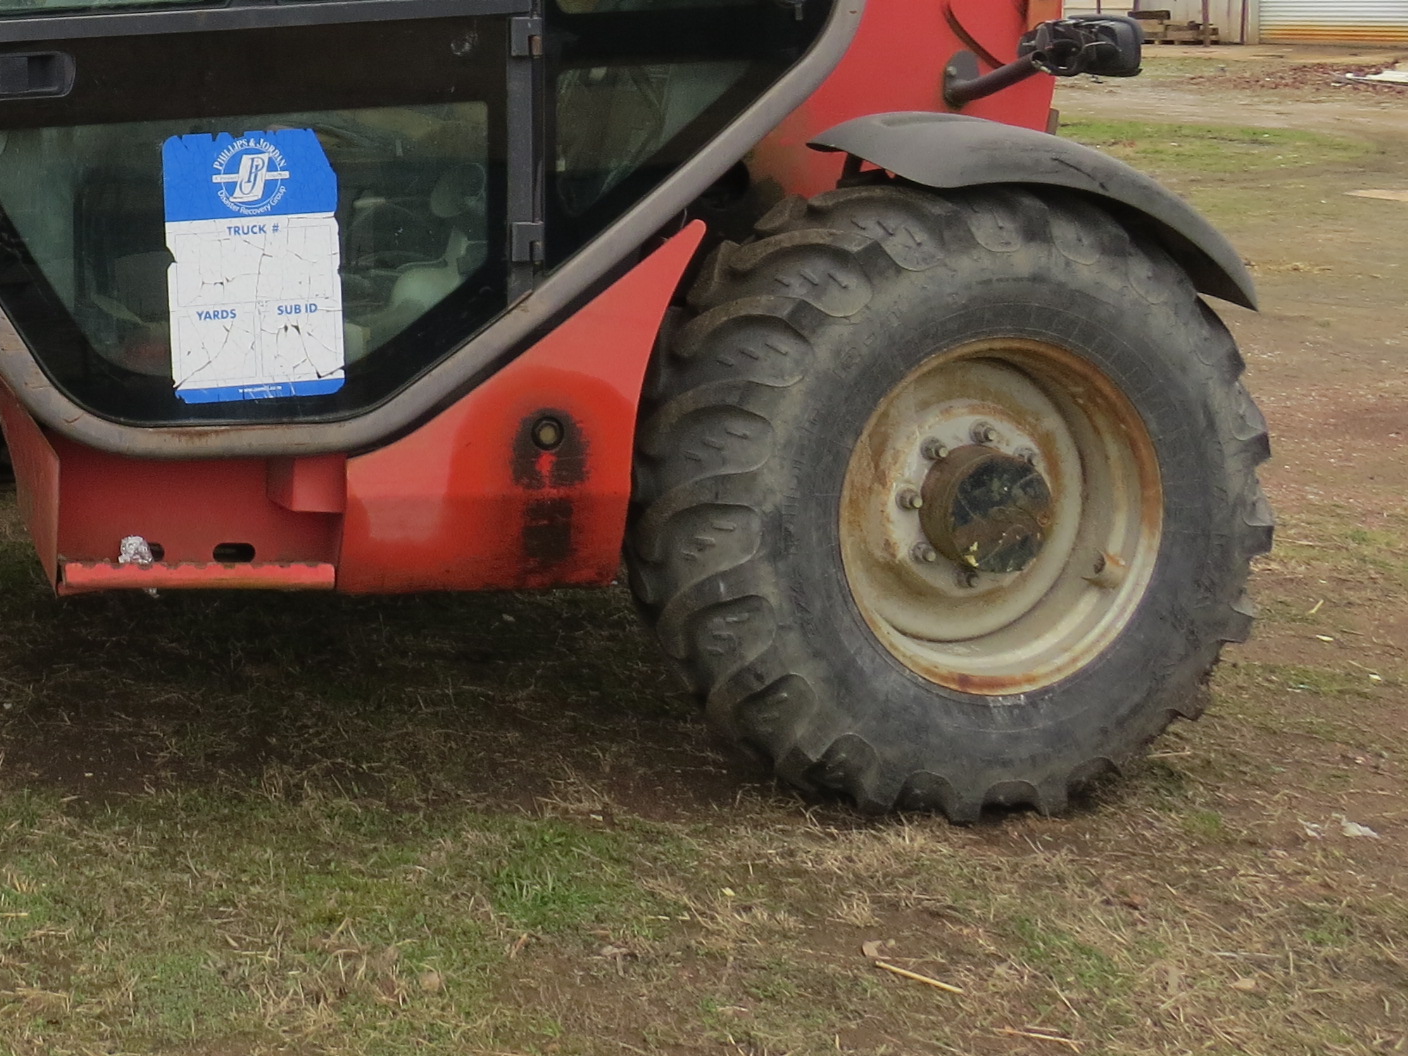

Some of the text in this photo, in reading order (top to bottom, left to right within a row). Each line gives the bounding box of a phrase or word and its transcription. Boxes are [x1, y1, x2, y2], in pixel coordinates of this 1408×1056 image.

[213, 137, 287, 170] PHILLIPS & JORDAN
[239, 203, 272, 215] Recovery
[269, 185, 287, 206] Group
[226, 223, 280, 236] TRUCK #
[196, 308, 237, 321] YARDS
[277, 302, 318, 316] SUB ID
